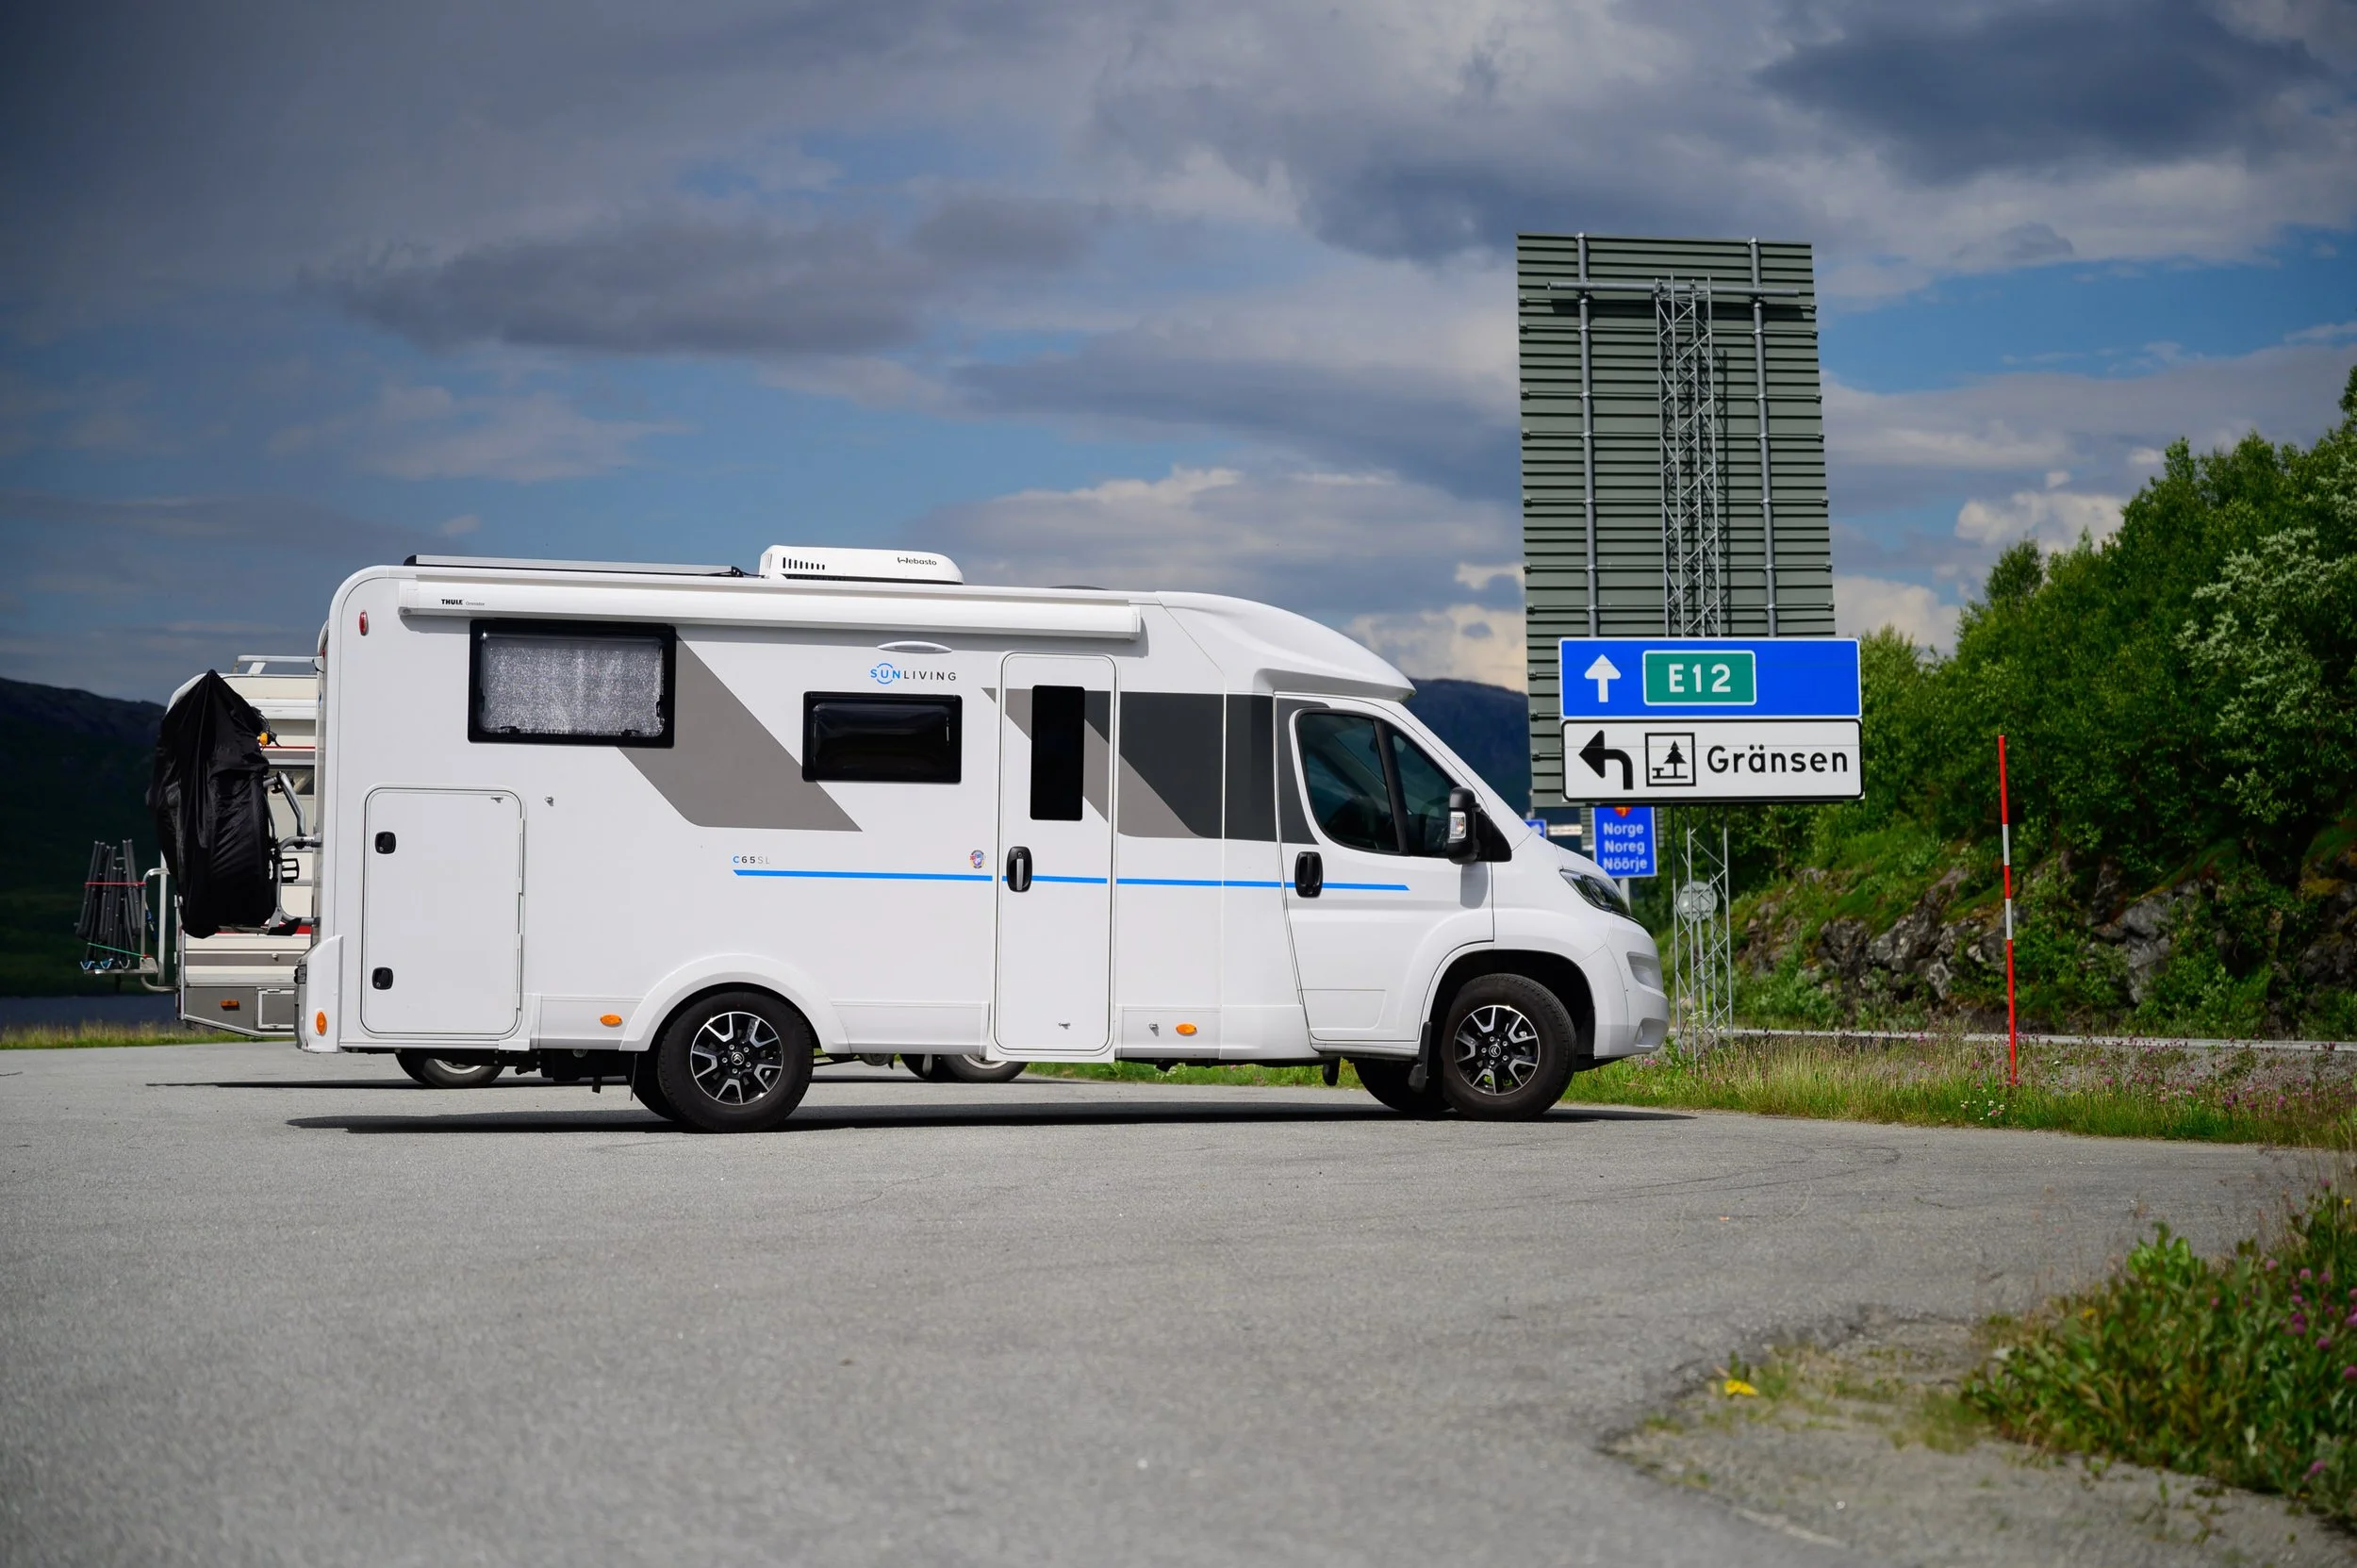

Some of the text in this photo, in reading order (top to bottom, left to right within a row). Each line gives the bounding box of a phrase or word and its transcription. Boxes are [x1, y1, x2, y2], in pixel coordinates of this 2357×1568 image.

[1668, 663, 1732, 693] E12
[1706, 744, 1849, 773] Gränsen
[1603, 822, 1644, 837] Norge
[1604, 840, 1645, 854] Noreg
[1603, 857, 1648, 872] Nöörje
